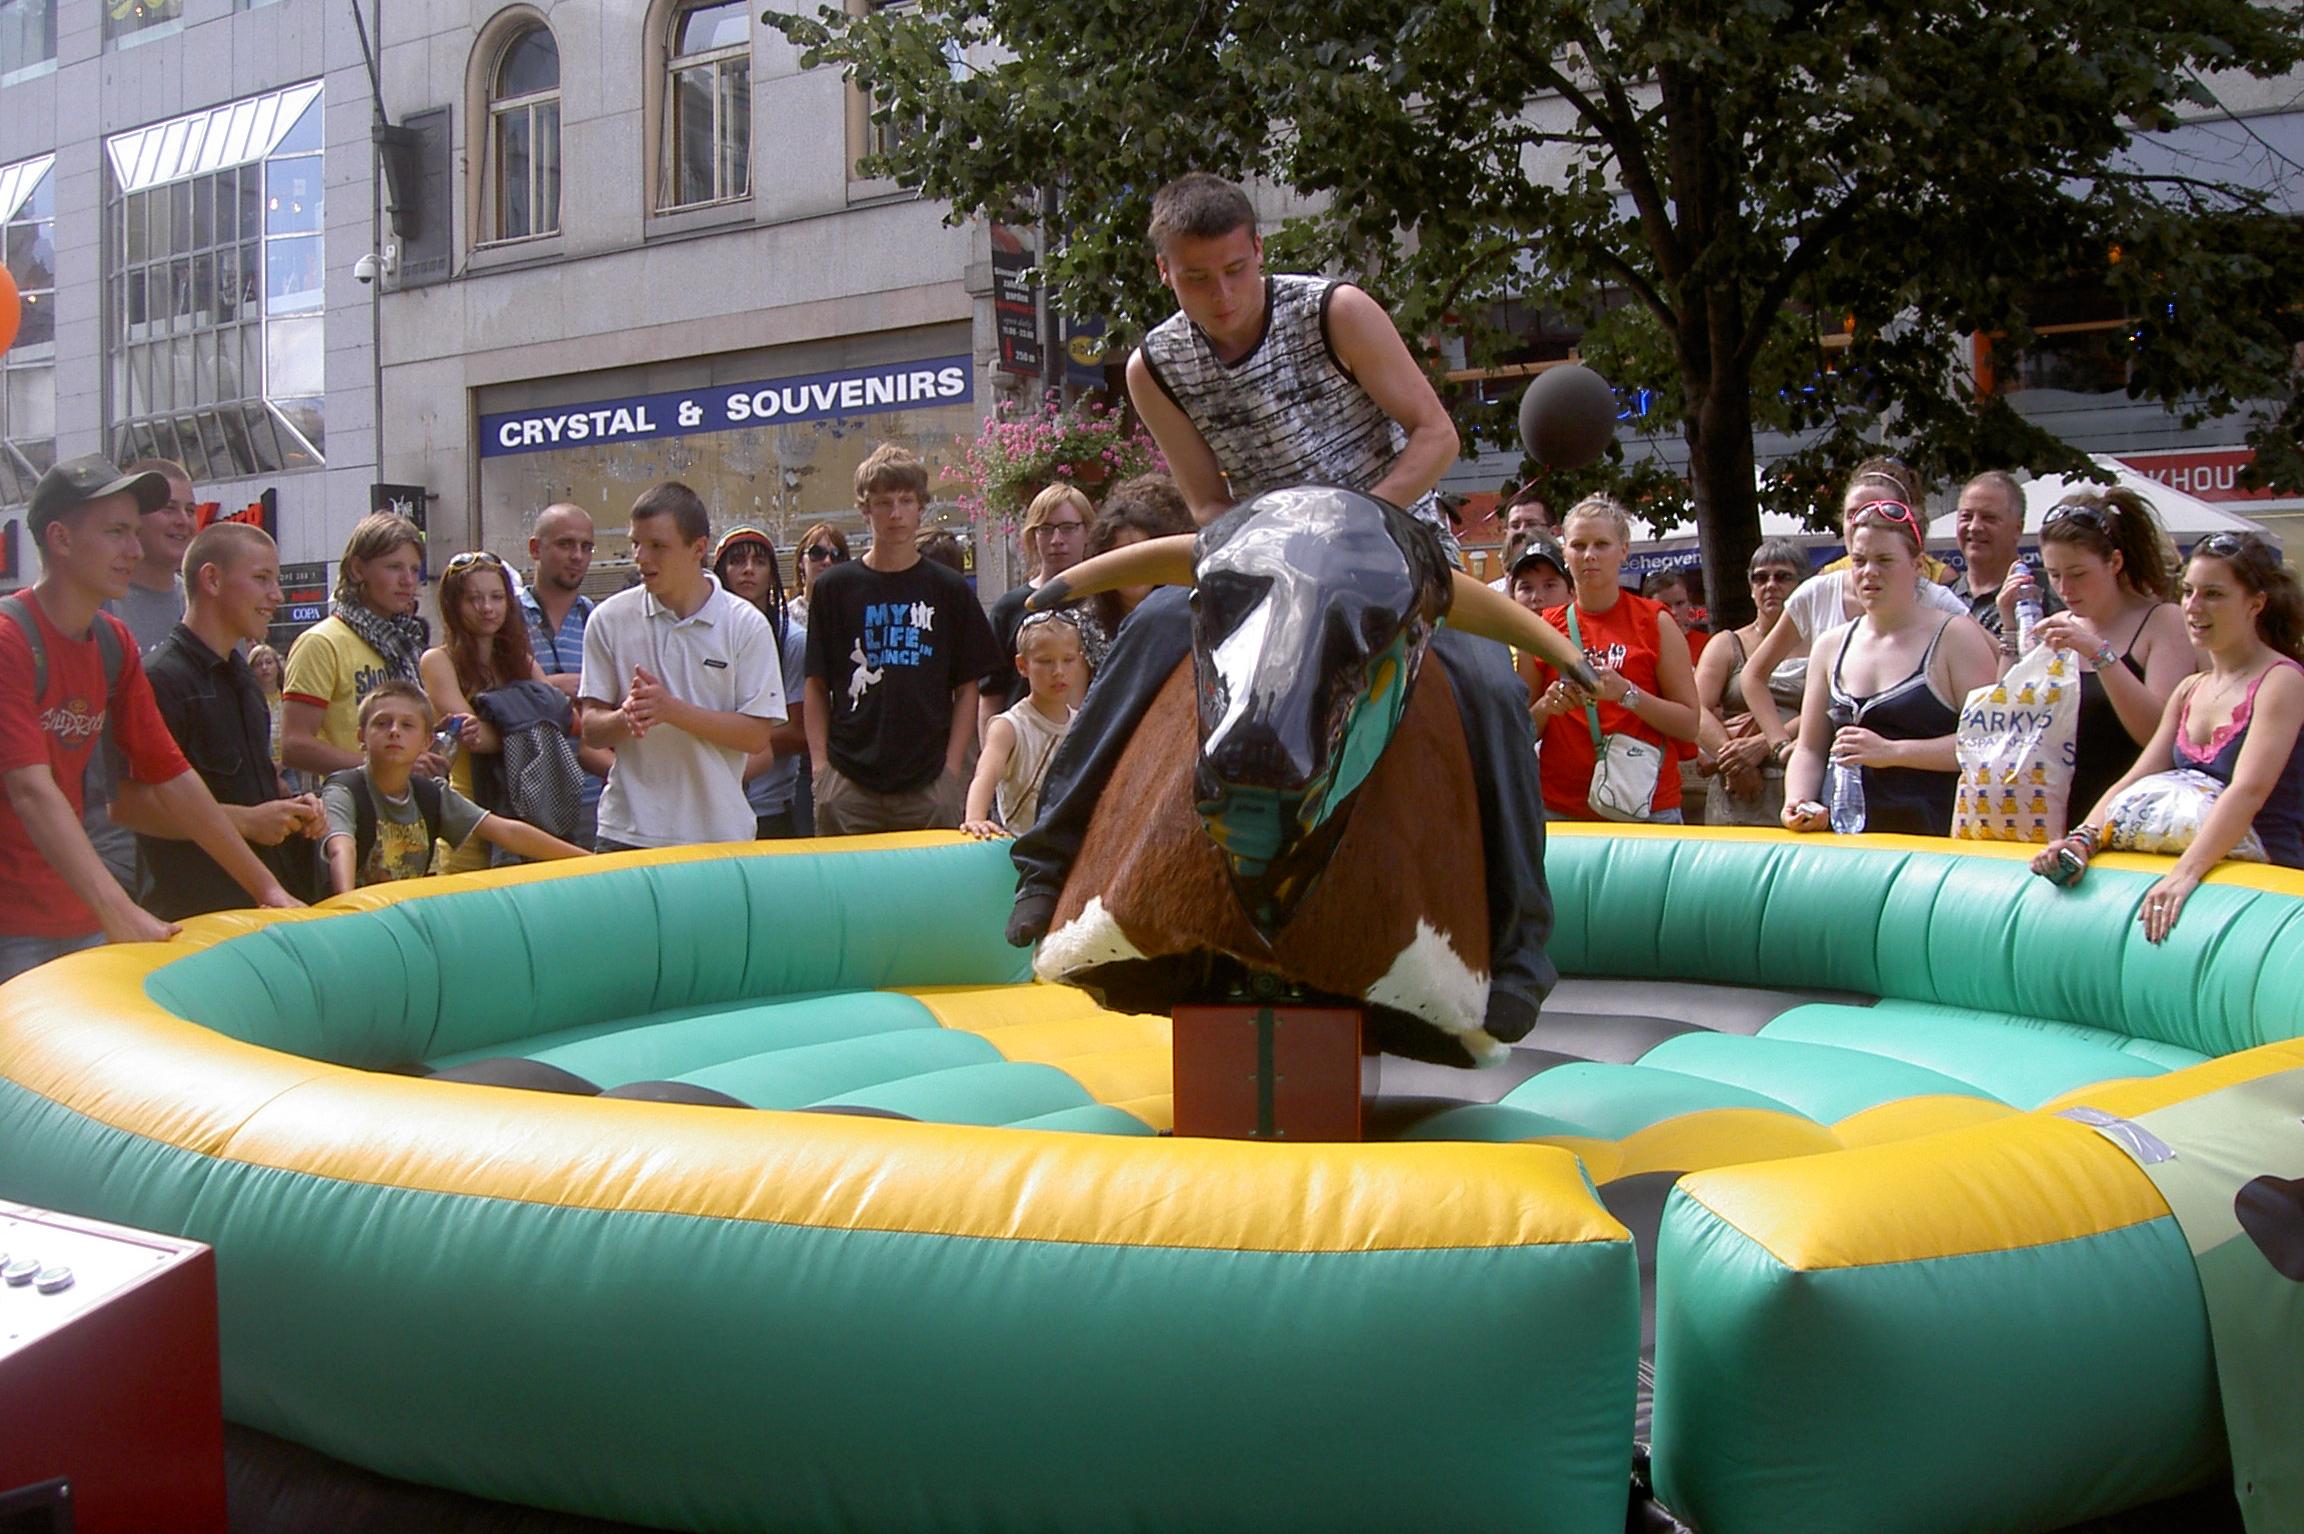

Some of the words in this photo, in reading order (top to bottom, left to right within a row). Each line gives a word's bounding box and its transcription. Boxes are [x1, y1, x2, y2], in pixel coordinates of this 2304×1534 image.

[498, 405, 657, 448] CRYSTAL
[678, 400, 703, 427] &
[726, 367, 966, 421] SOUVENIRS
[2136, 465, 2235, 492] KHOU
[293, 607, 320, 620] COPA
[865, 603, 910, 627] MY
[865, 626, 919, 649] LIFE
[919, 643, 933, 657] IN
